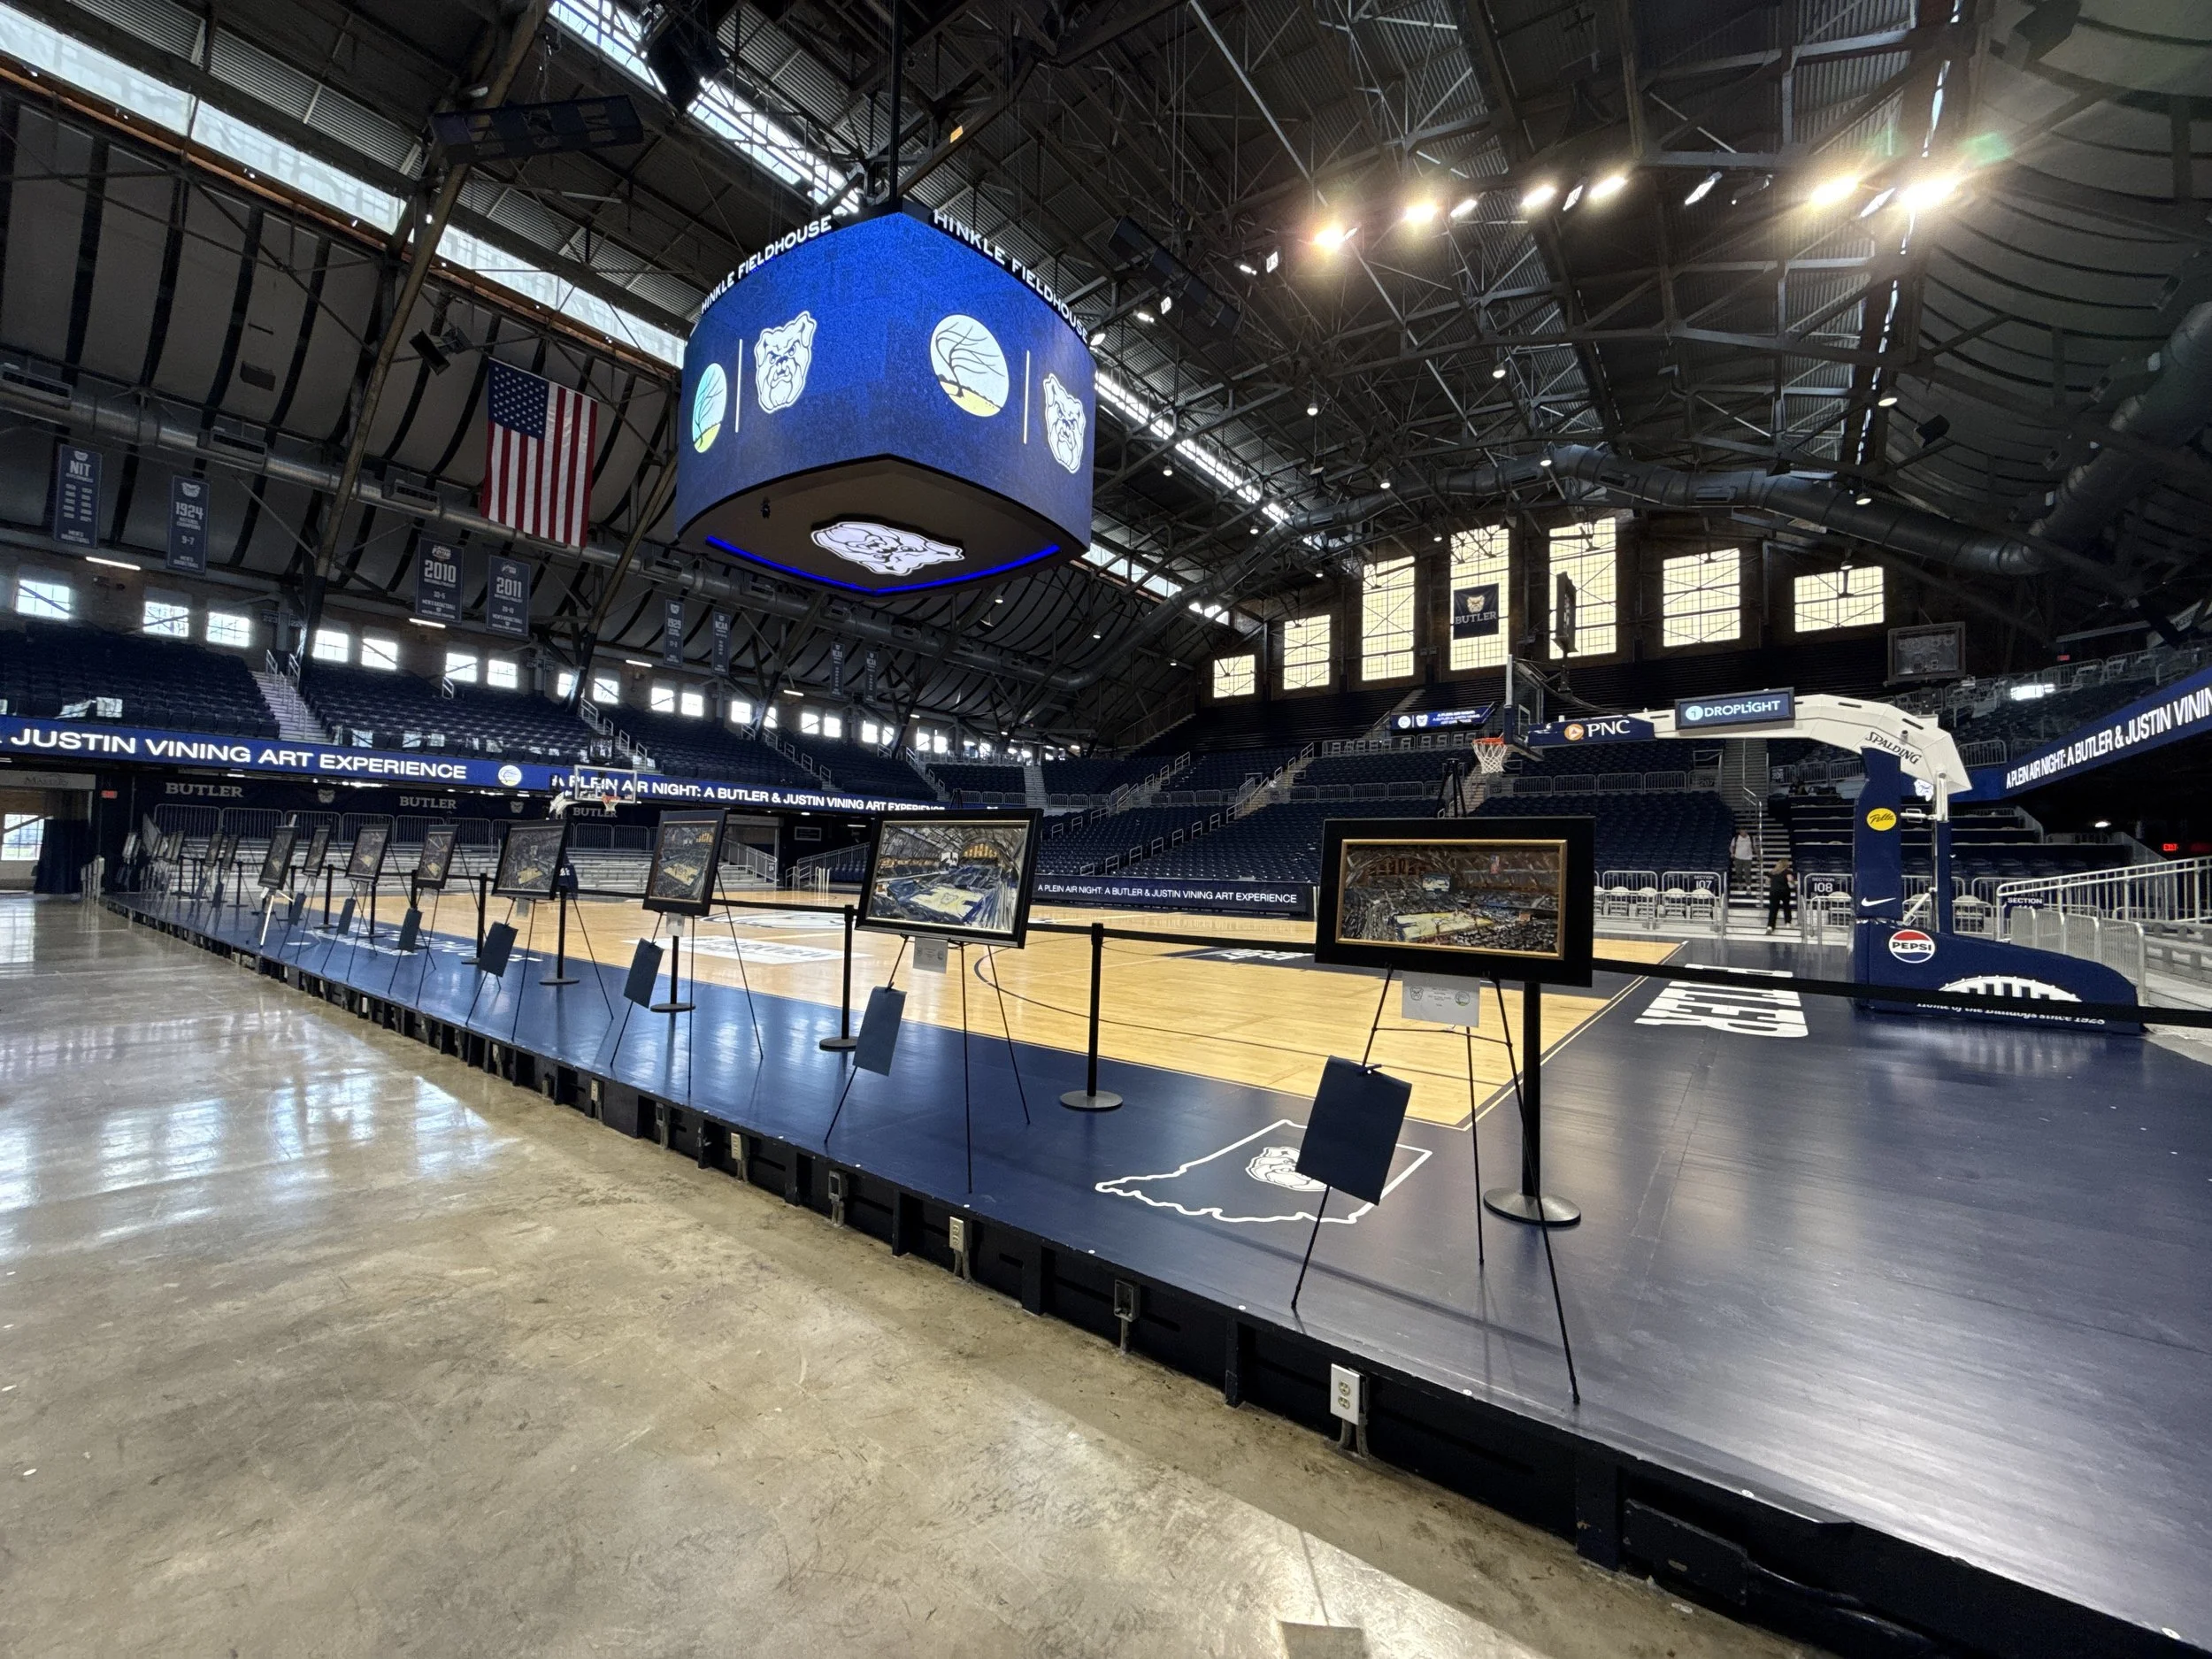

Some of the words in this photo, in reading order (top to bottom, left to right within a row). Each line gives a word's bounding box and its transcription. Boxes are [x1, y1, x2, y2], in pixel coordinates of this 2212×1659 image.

[701, 271, 734, 314] HINKLE
[738, 215, 832, 280] FIELDHOUSE
[933, 209, 1005, 265] HINKLE
[1011, 257, 1088, 343] FIELDHOUSE
[70, 460, 92, 477] NIT
[175, 502, 204, 520] 1924
[424, 559, 457, 583] 2010
[496, 577, 522, 598] 2011
[1455, 611, 1497, 625] BUTLER
[1587, 719, 1631, 738] PNC
[1865, 731, 1922, 765] SPALDING
[2041, 749, 2066, 776] NIGHT:
[2067, 746, 2075, 766] A
[2075, 729, 2113, 764] BUTLER
[2115, 725, 2124, 749] &
[2125, 703, 2171, 745] JUSTIN
[11, 728, 135, 754] JUSTIN
[145, 739, 251, 763] VINING
[258, 749, 314, 767] ART
[319, 754, 467, 780] EXPERIENCE
[165, 783, 244, 797] BUTLER
[621, 780, 648, 793] AR
[652, 782, 701, 797] NIGHT:
[703, 787, 715, 798] A
[718, 787, 768, 803] BUTLER
[772, 793, 780, 803] &
[783, 795, 825, 807] JUSTIN
[826, 797, 864, 810] VINING
[865, 801, 886, 811] ART
[400, 796, 457, 810] BUTLER
[573, 807, 618, 818] BUTLER
[1870, 813, 1894, 825] Pella
[1696, 880, 1712, 889] 107
[1814, 882, 1832, 893] 108
[1111, 887, 1143, 896] BUTLER
[1151, 889, 1181, 899] JUSTIN
[1182, 890, 1213, 900] VINING
[1215, 891, 1234, 901] ART
[1236, 892, 1297, 903] EXPERIENCE
[1892, 941, 1932, 951] PEPSI
